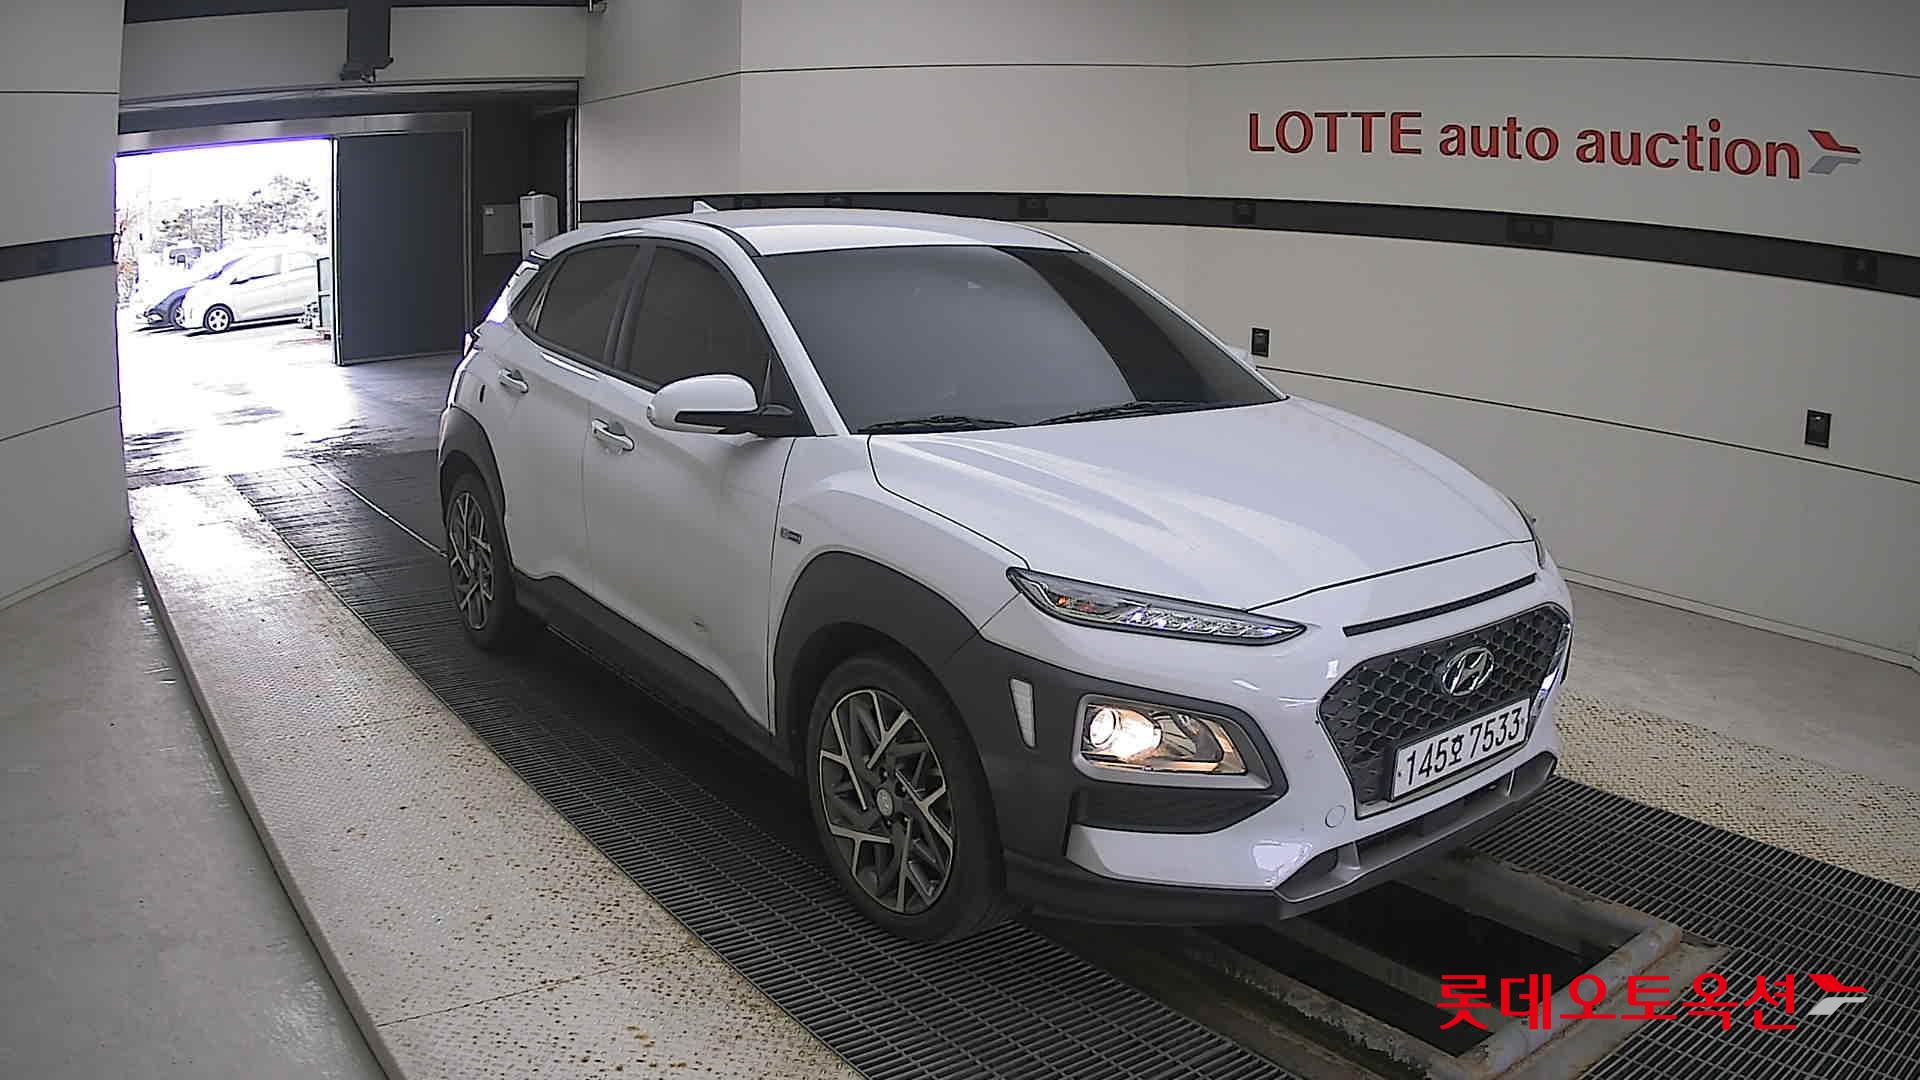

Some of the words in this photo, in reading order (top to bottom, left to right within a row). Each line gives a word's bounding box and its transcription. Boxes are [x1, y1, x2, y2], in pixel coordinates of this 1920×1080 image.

[1248, 111, 1423, 155] LOTTE
[1439, 116, 1559, 161] auto
[1575, 118, 1801, 180] auction
[1469, 706, 1523, 759] 7533
